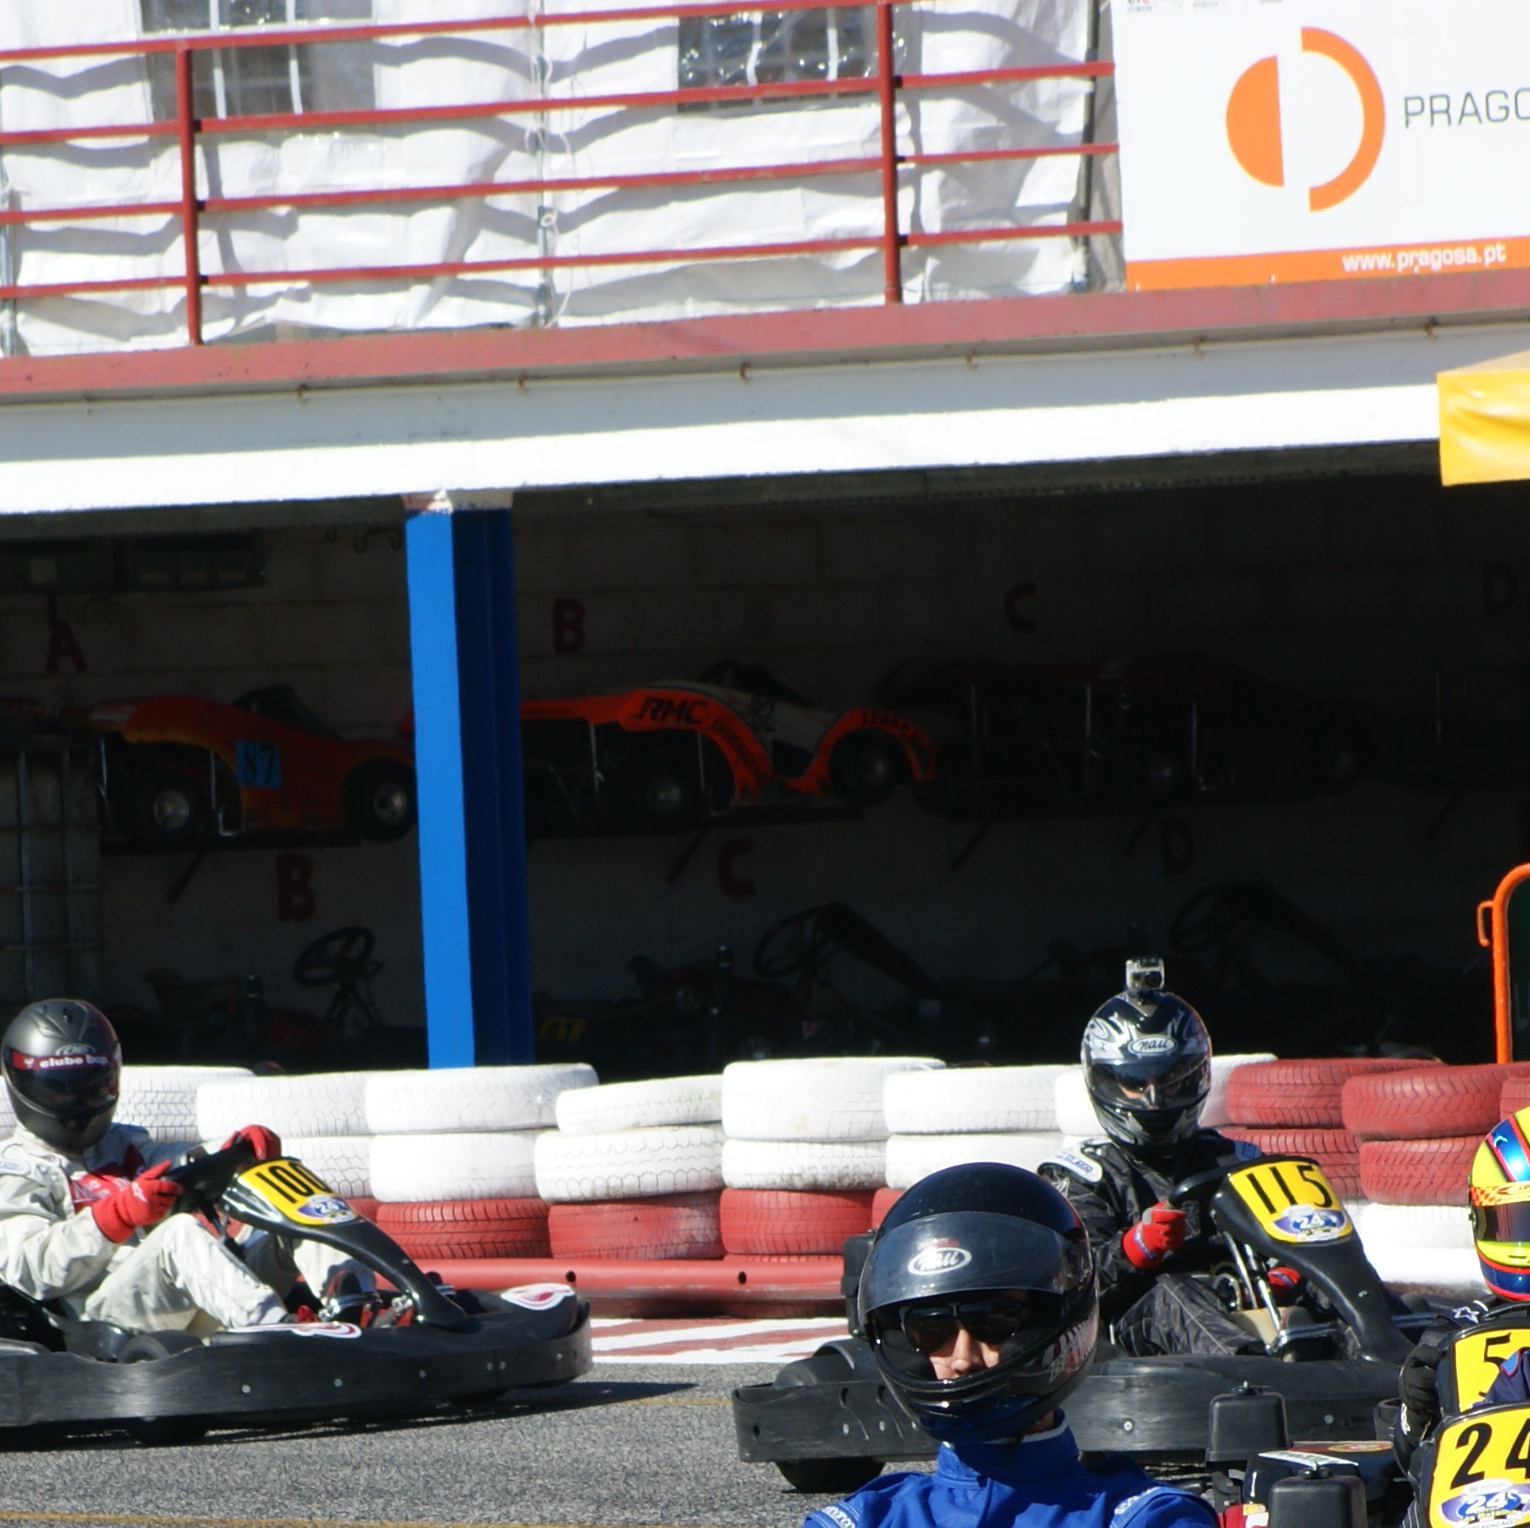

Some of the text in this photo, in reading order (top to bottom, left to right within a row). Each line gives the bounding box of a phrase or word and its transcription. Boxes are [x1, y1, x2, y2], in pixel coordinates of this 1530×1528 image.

[1342, 243, 1507, 274] www.pragosa.pt
[45, 619, 88, 677] A
[276, 852, 316, 923] B
[254, 1160, 334, 1205] 100
[1245, 1164, 1333, 1215] 115
